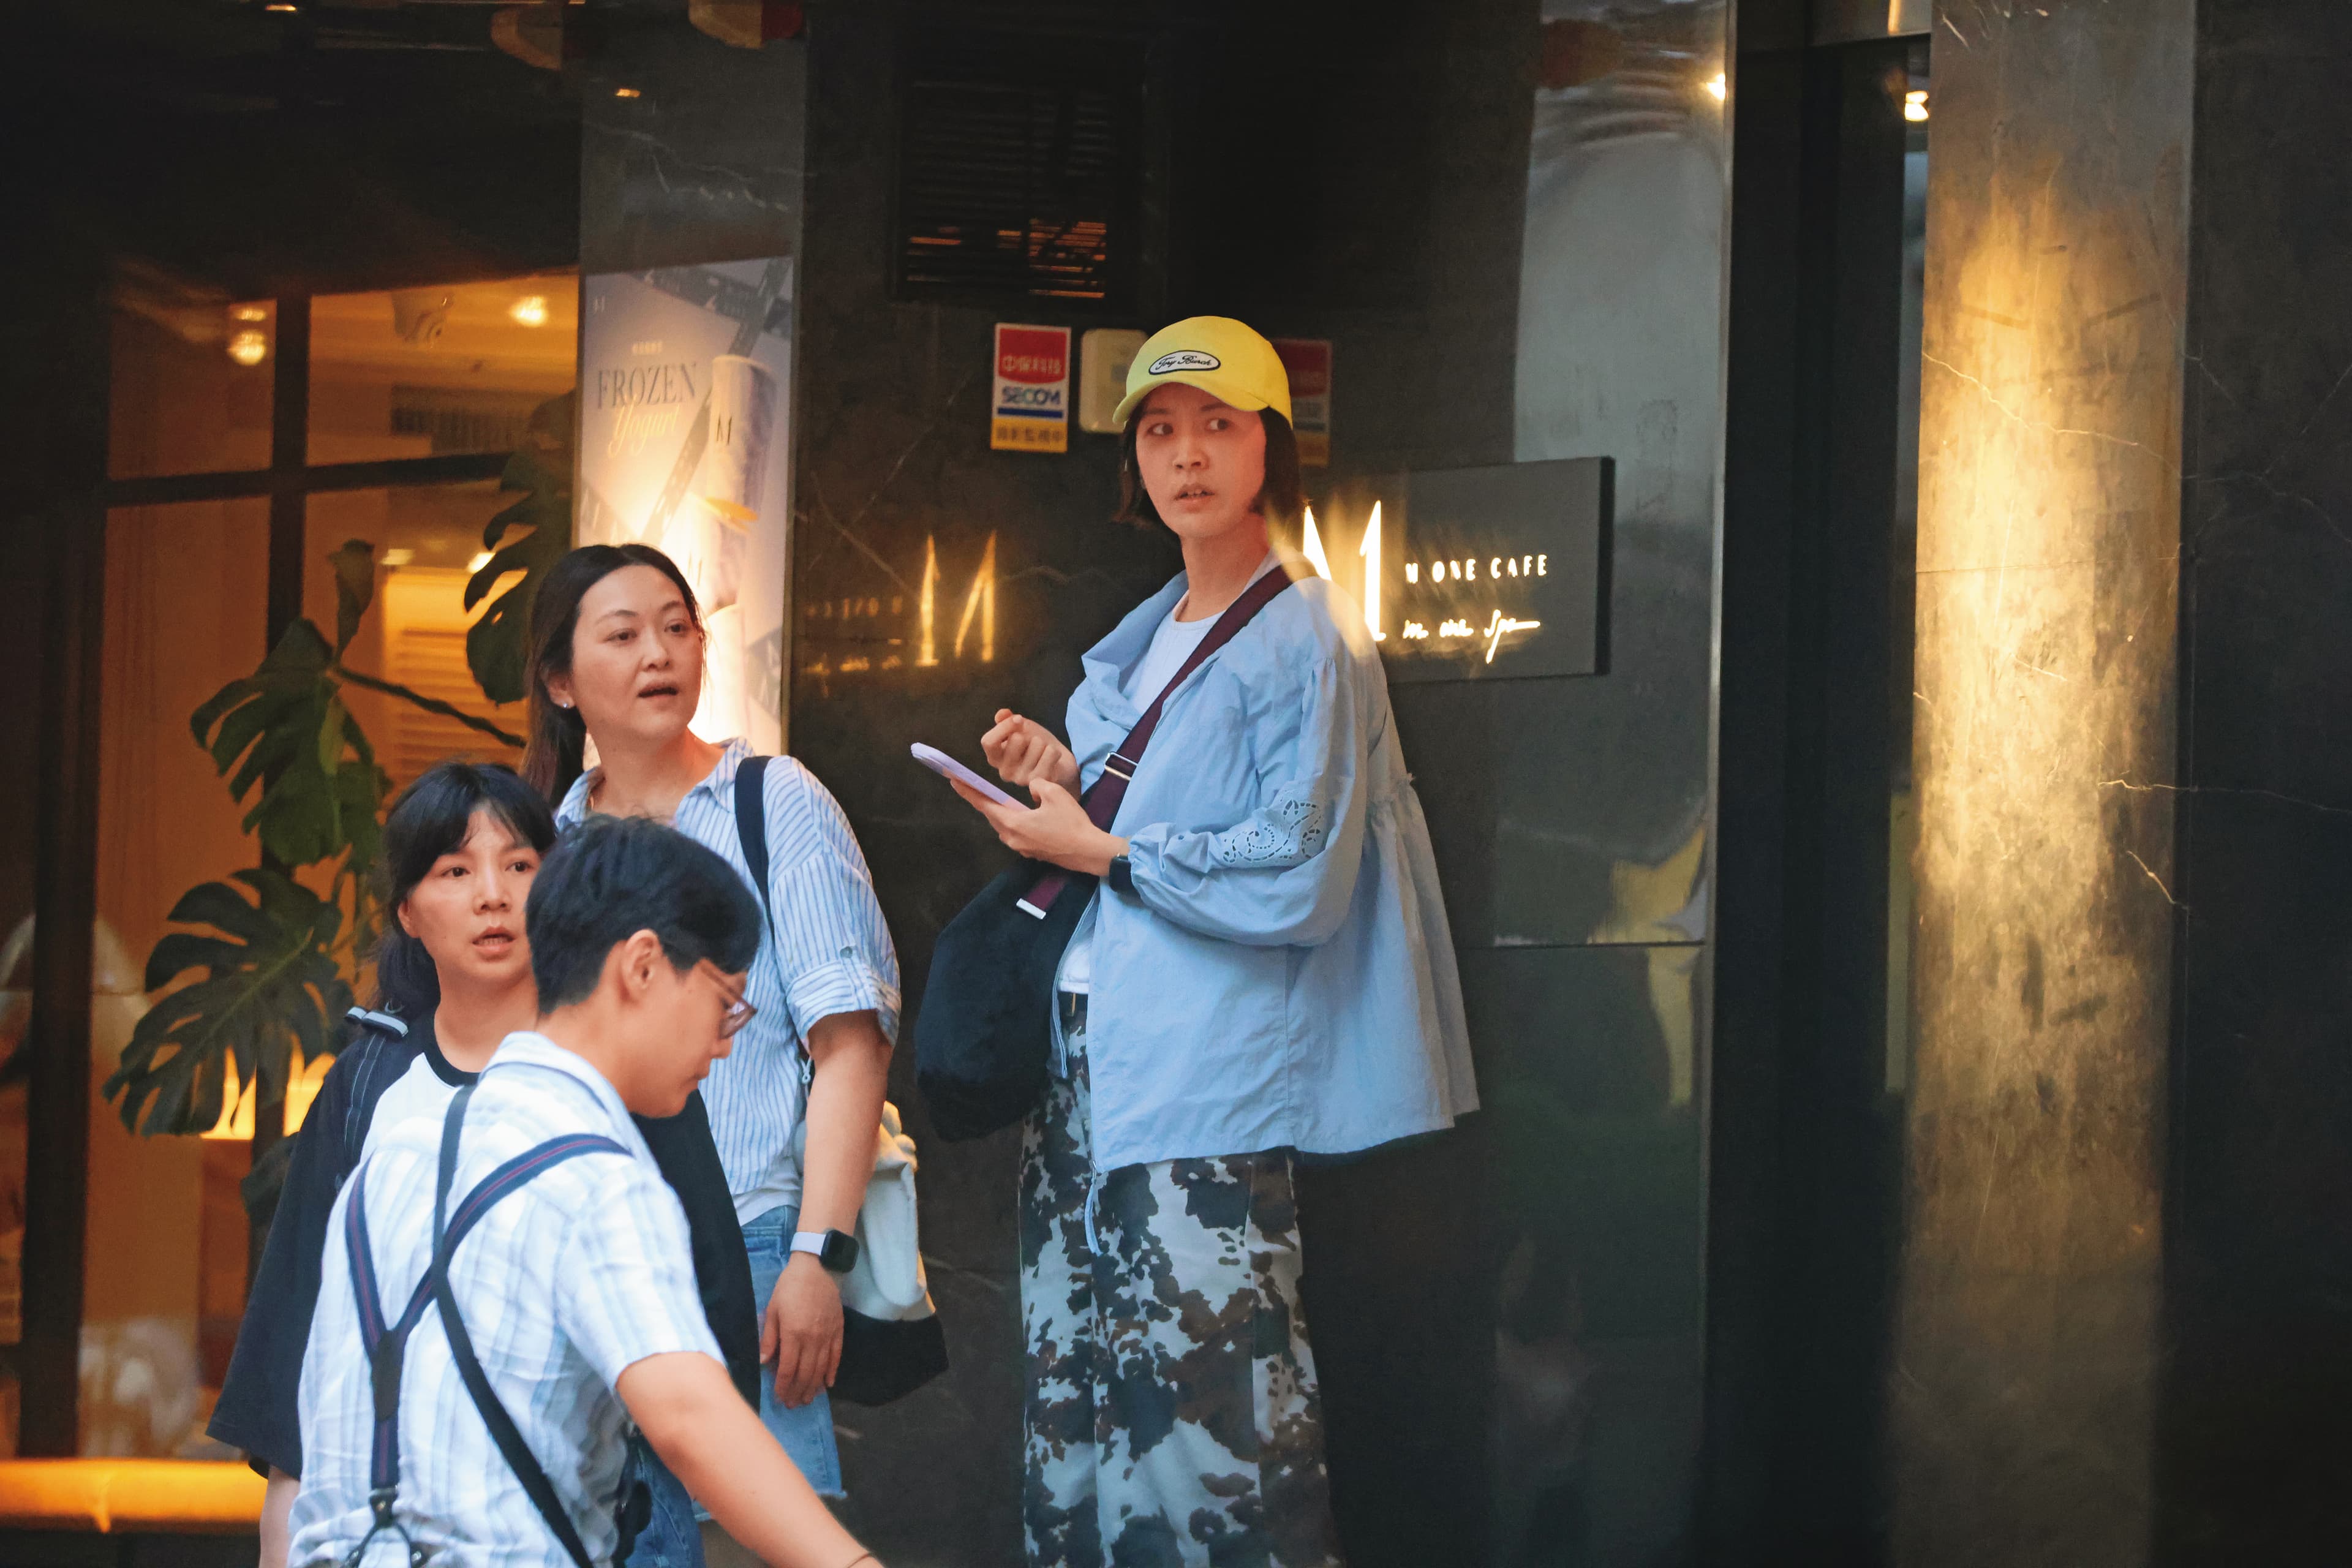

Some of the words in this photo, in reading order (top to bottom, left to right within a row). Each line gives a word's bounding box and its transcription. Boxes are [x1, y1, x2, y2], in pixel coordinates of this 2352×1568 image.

[1155, 356, 1177, 370] Tory
[1177, 355, 1212, 366] Burch
[598, 362, 696, 409] FROZEN
[1003, 385, 1061, 405] SECOM
[1432, 559, 1476, 582] ONE
[1491, 554, 1547, 579] CAFE
